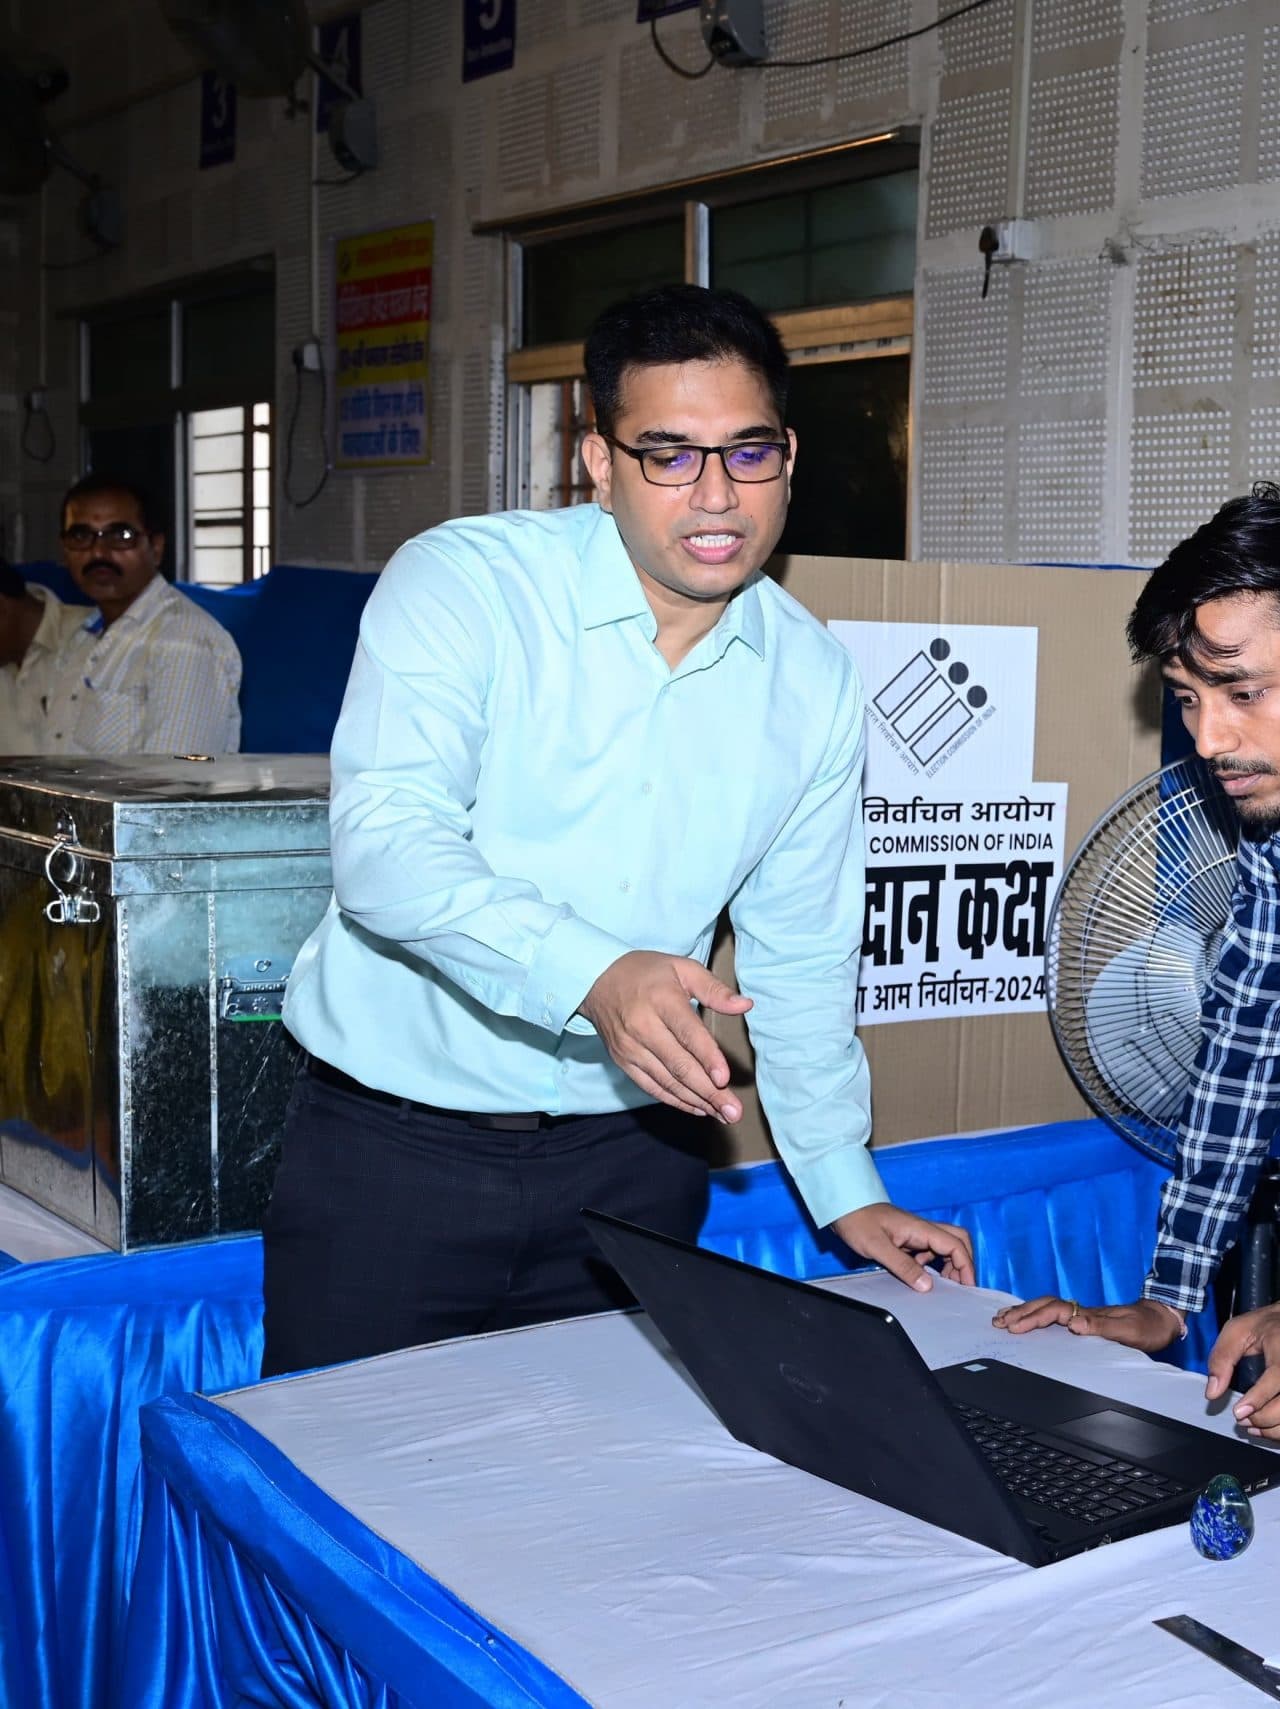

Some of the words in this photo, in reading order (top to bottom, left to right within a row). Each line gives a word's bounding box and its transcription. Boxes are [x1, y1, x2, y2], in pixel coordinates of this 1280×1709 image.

[863, 796, 963, 824] निर्वाचन
[971, 796, 1056, 822] आयोग
[869, 833, 979, 854] COMMISSION
[984, 834, 1005, 851] OF
[1009, 833, 1053, 850] INDIA
[861, 864, 946, 966] दान
[954, 860, 1054, 960] कक्ष
[873, 983, 912, 1011] आम
